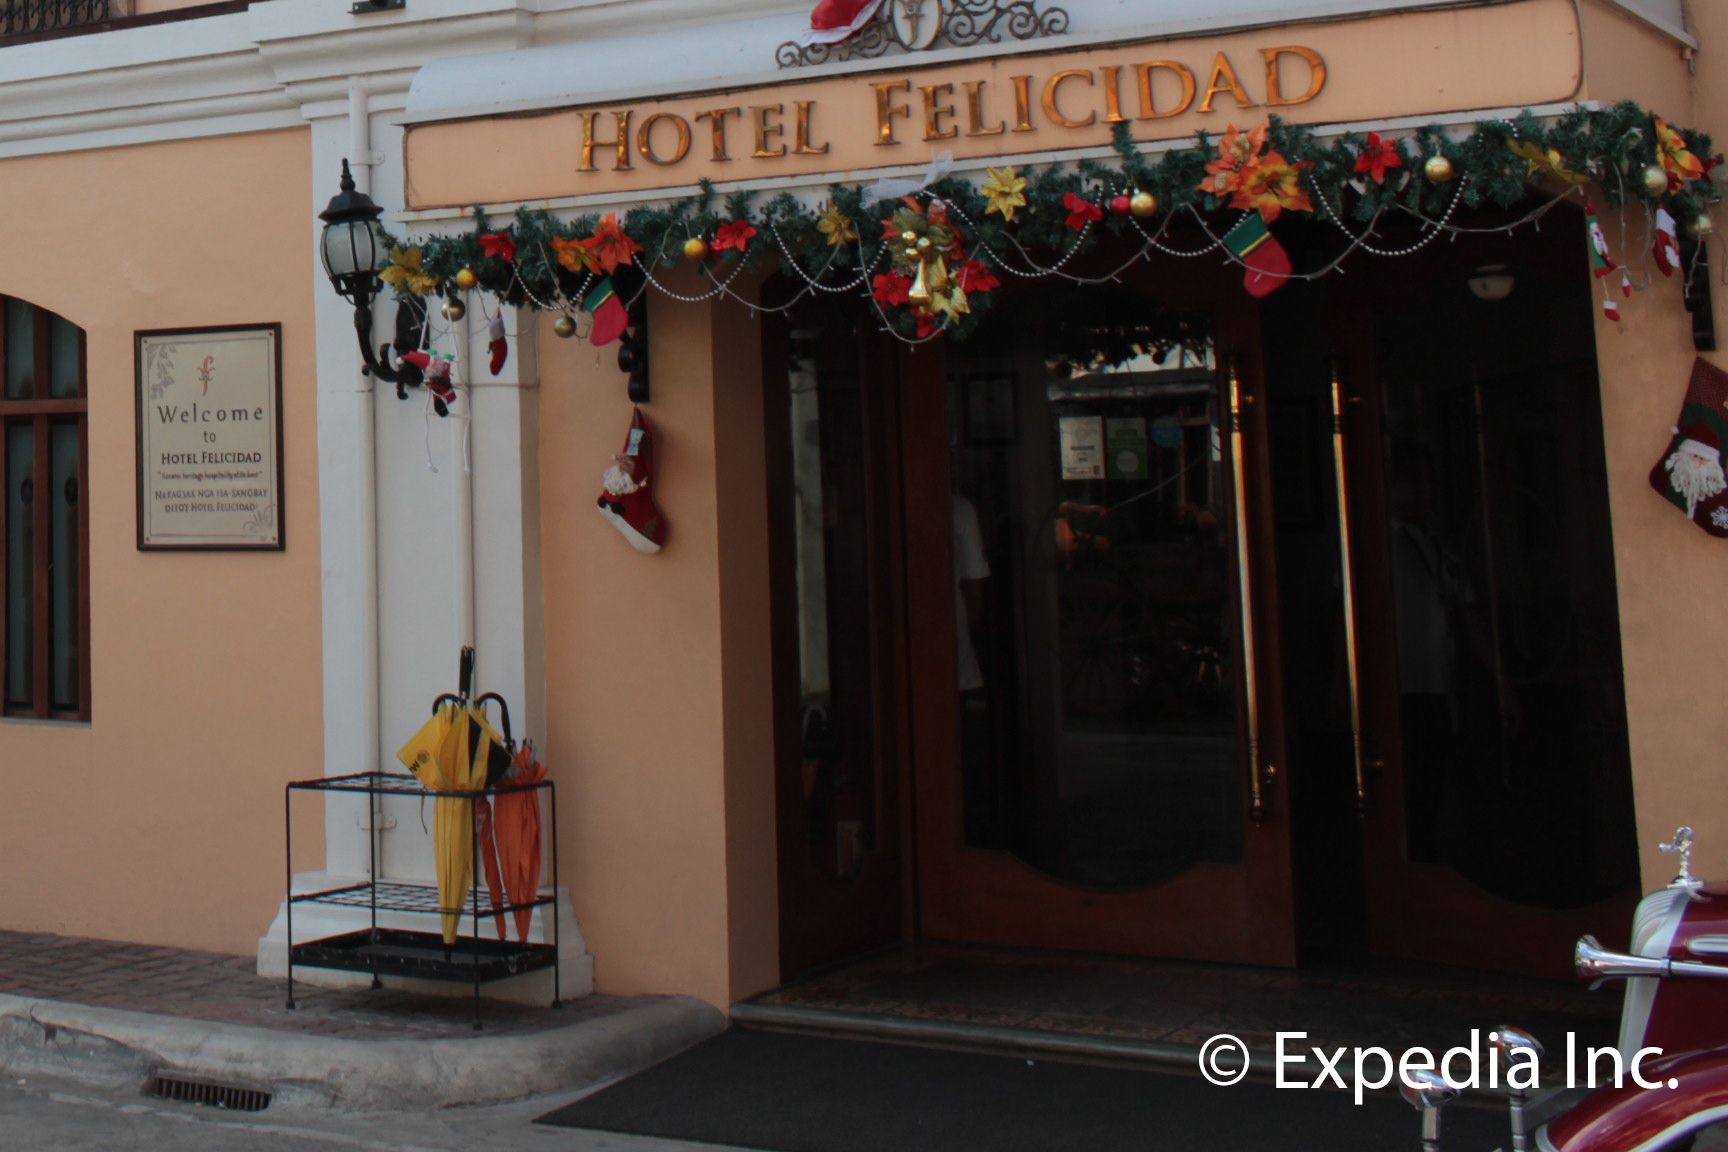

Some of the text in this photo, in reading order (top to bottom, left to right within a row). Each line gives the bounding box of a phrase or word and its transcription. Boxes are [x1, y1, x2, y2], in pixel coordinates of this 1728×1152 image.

[575, 45, 1328, 173] HOTEL FELICIDAD
[157, 402, 263, 425] Welcome
[203, 431, 217, 444] to
[161, 451, 262, 465] HOTEL FELICIDAD
